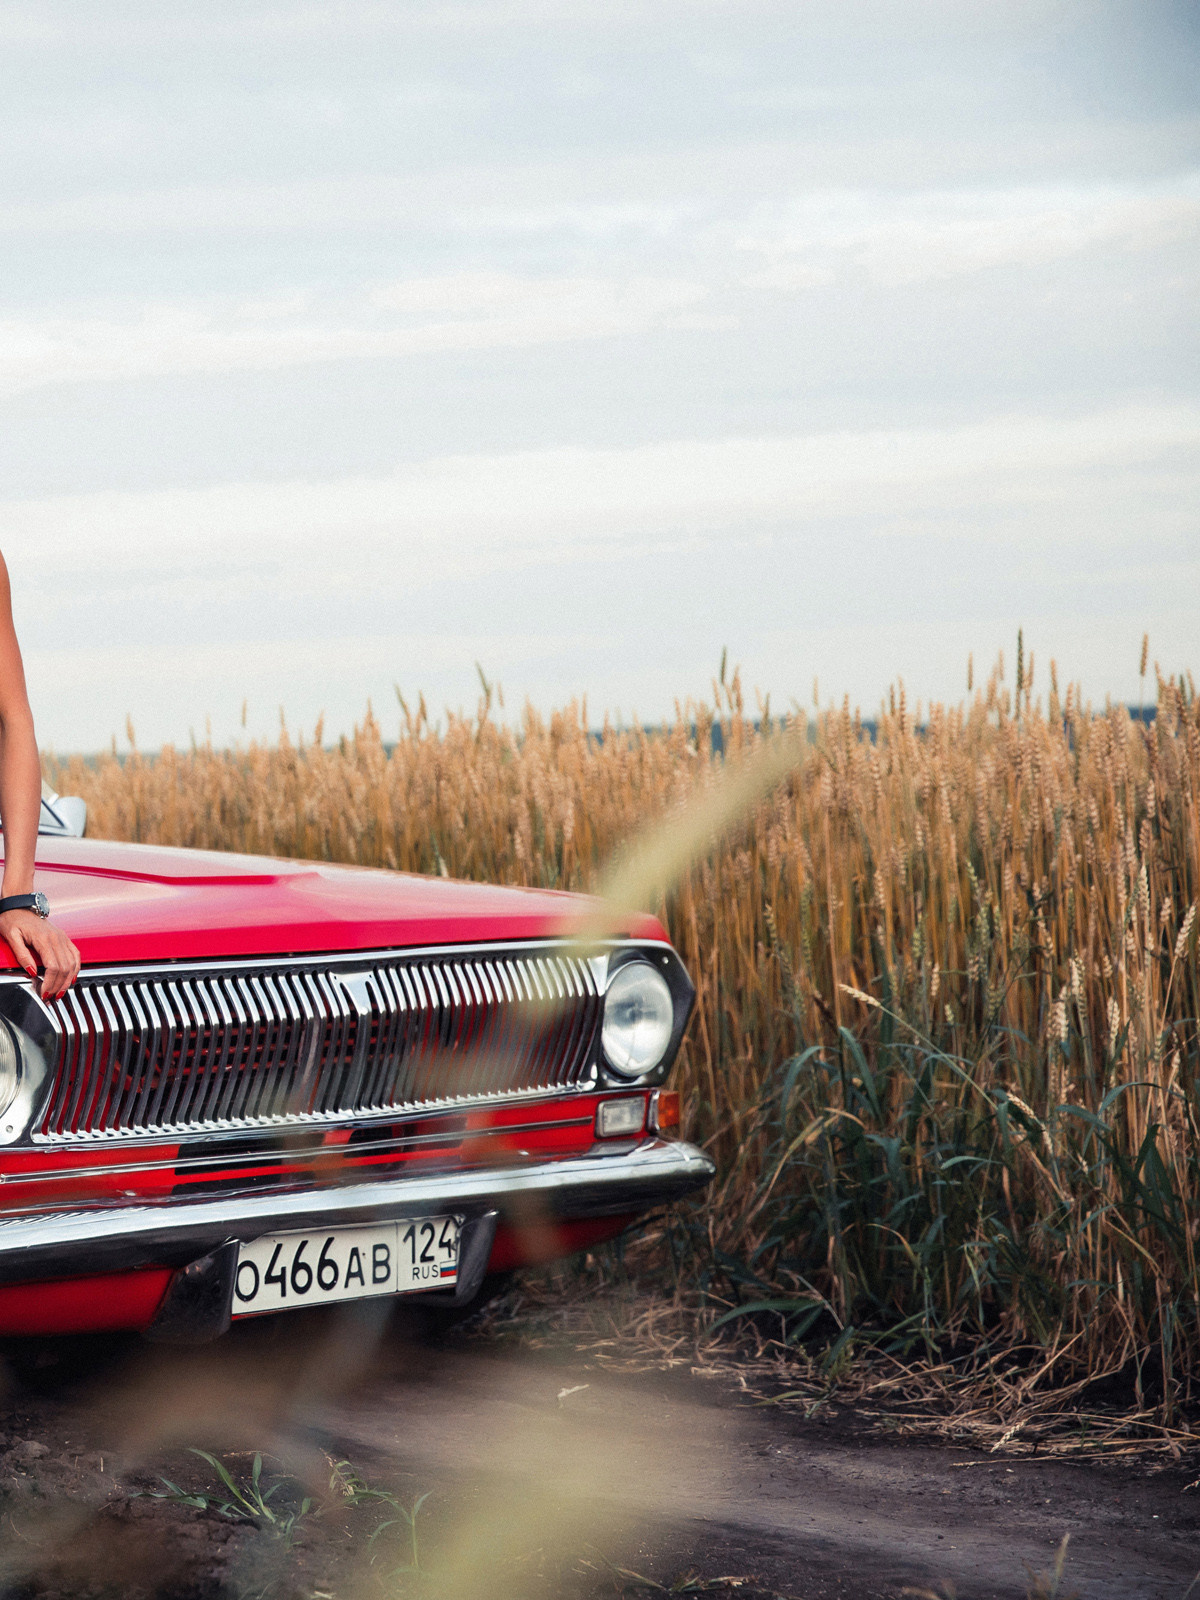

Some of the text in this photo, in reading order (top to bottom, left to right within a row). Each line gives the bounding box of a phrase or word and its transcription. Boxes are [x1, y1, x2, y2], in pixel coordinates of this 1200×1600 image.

[234, 1219, 455, 1302] O466AB 124
[412, 1264, 439, 1281] RUS
